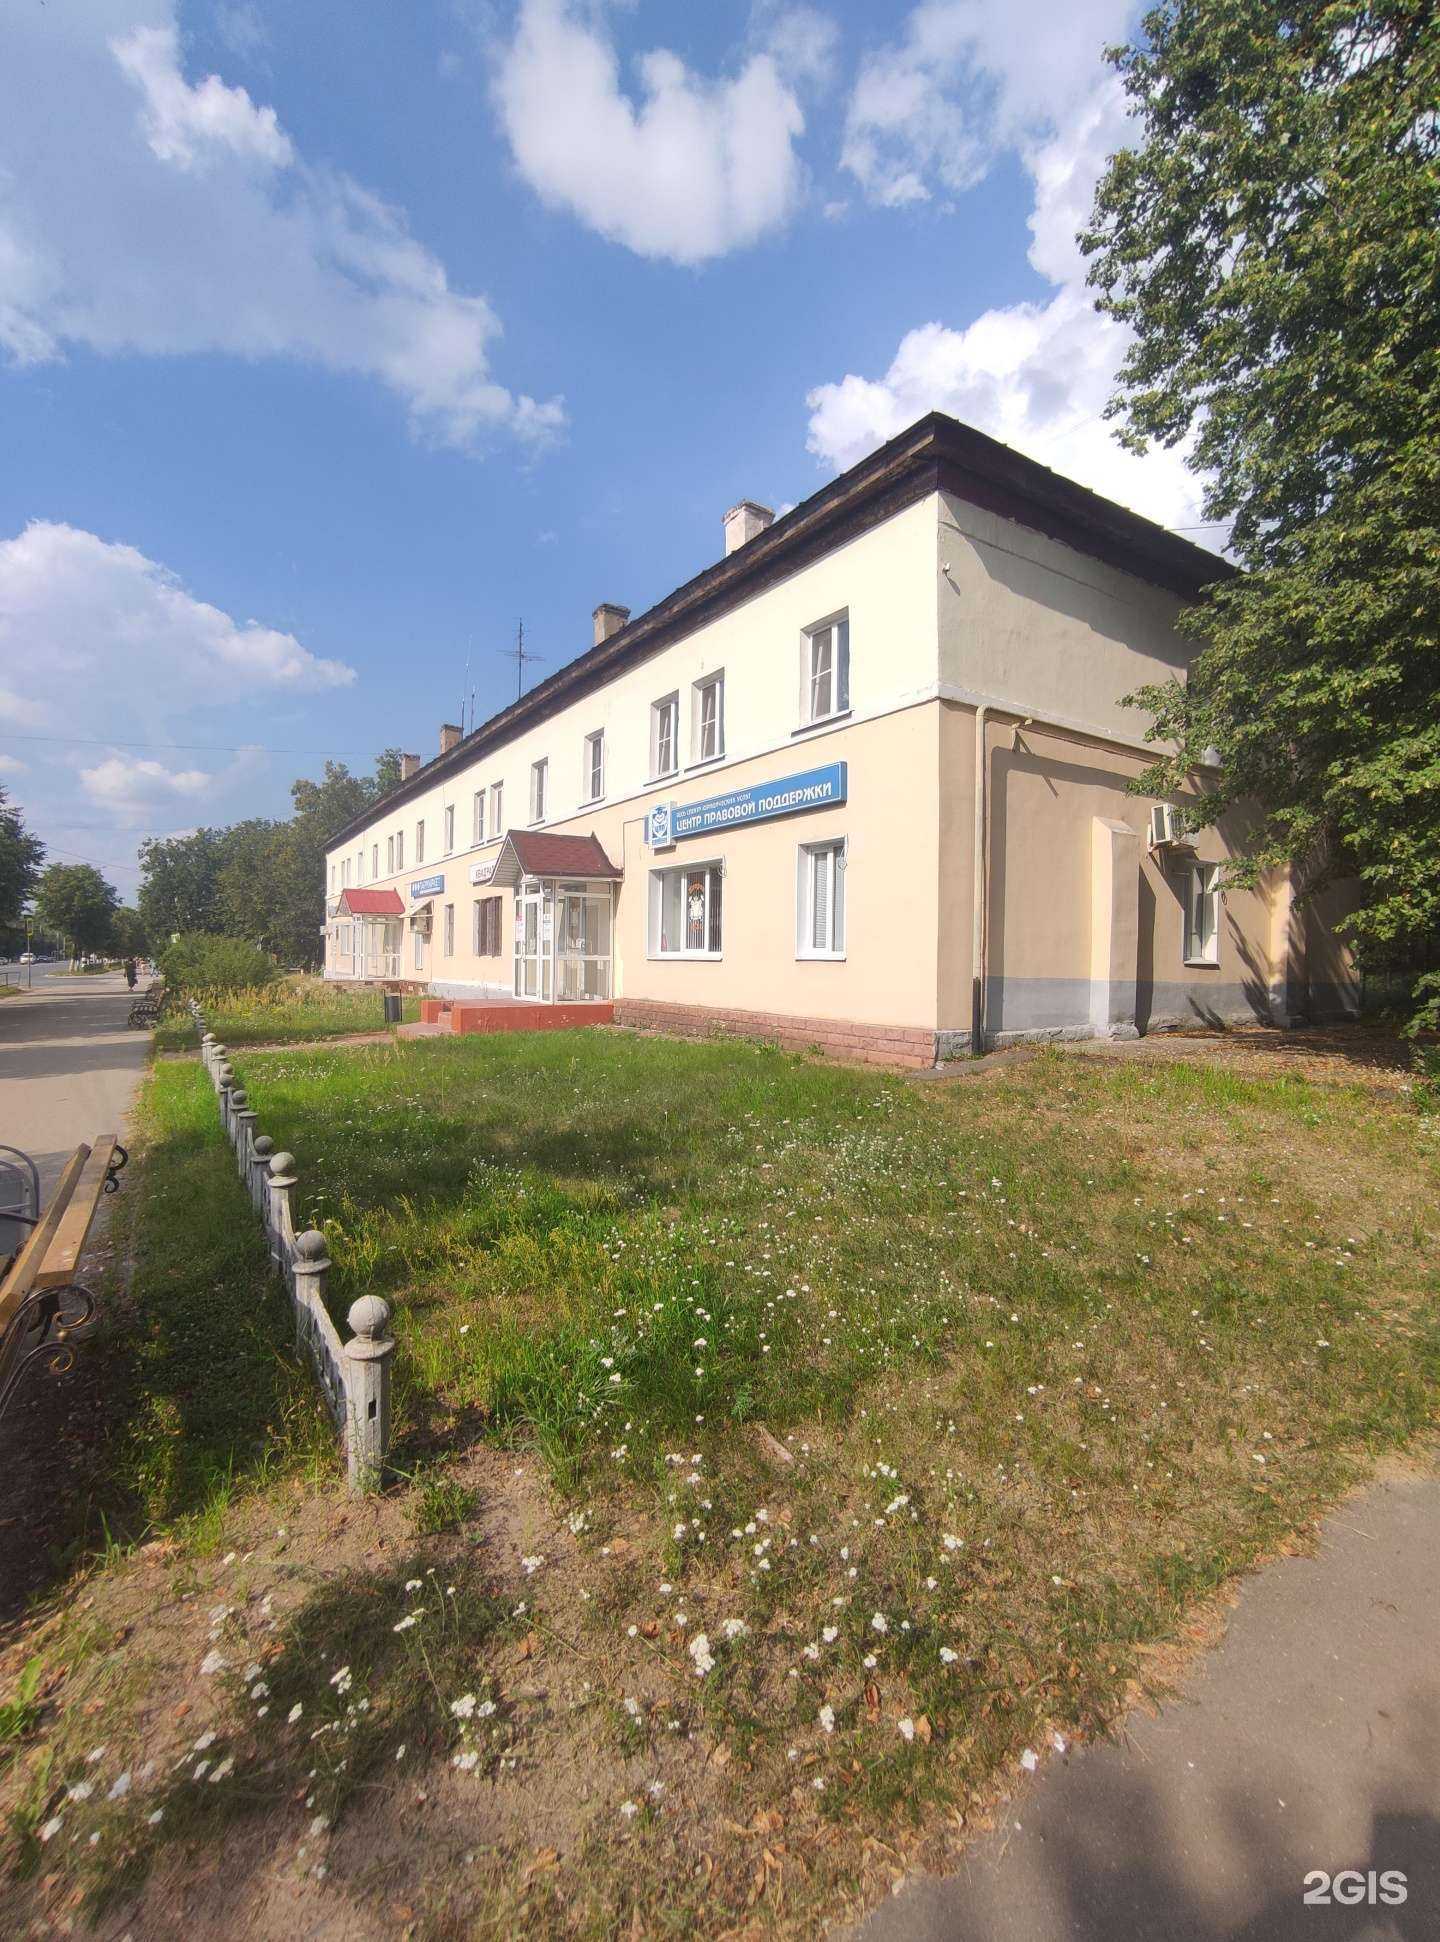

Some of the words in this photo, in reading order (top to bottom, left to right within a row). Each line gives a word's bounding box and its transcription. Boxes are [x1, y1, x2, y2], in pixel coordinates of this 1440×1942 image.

[676, 815, 702, 831] ЦЕНТР
[704, 801, 756, 825] ПРАВОВОЙ
[758, 781, 832, 812] ПОДДЕРЖКИ
